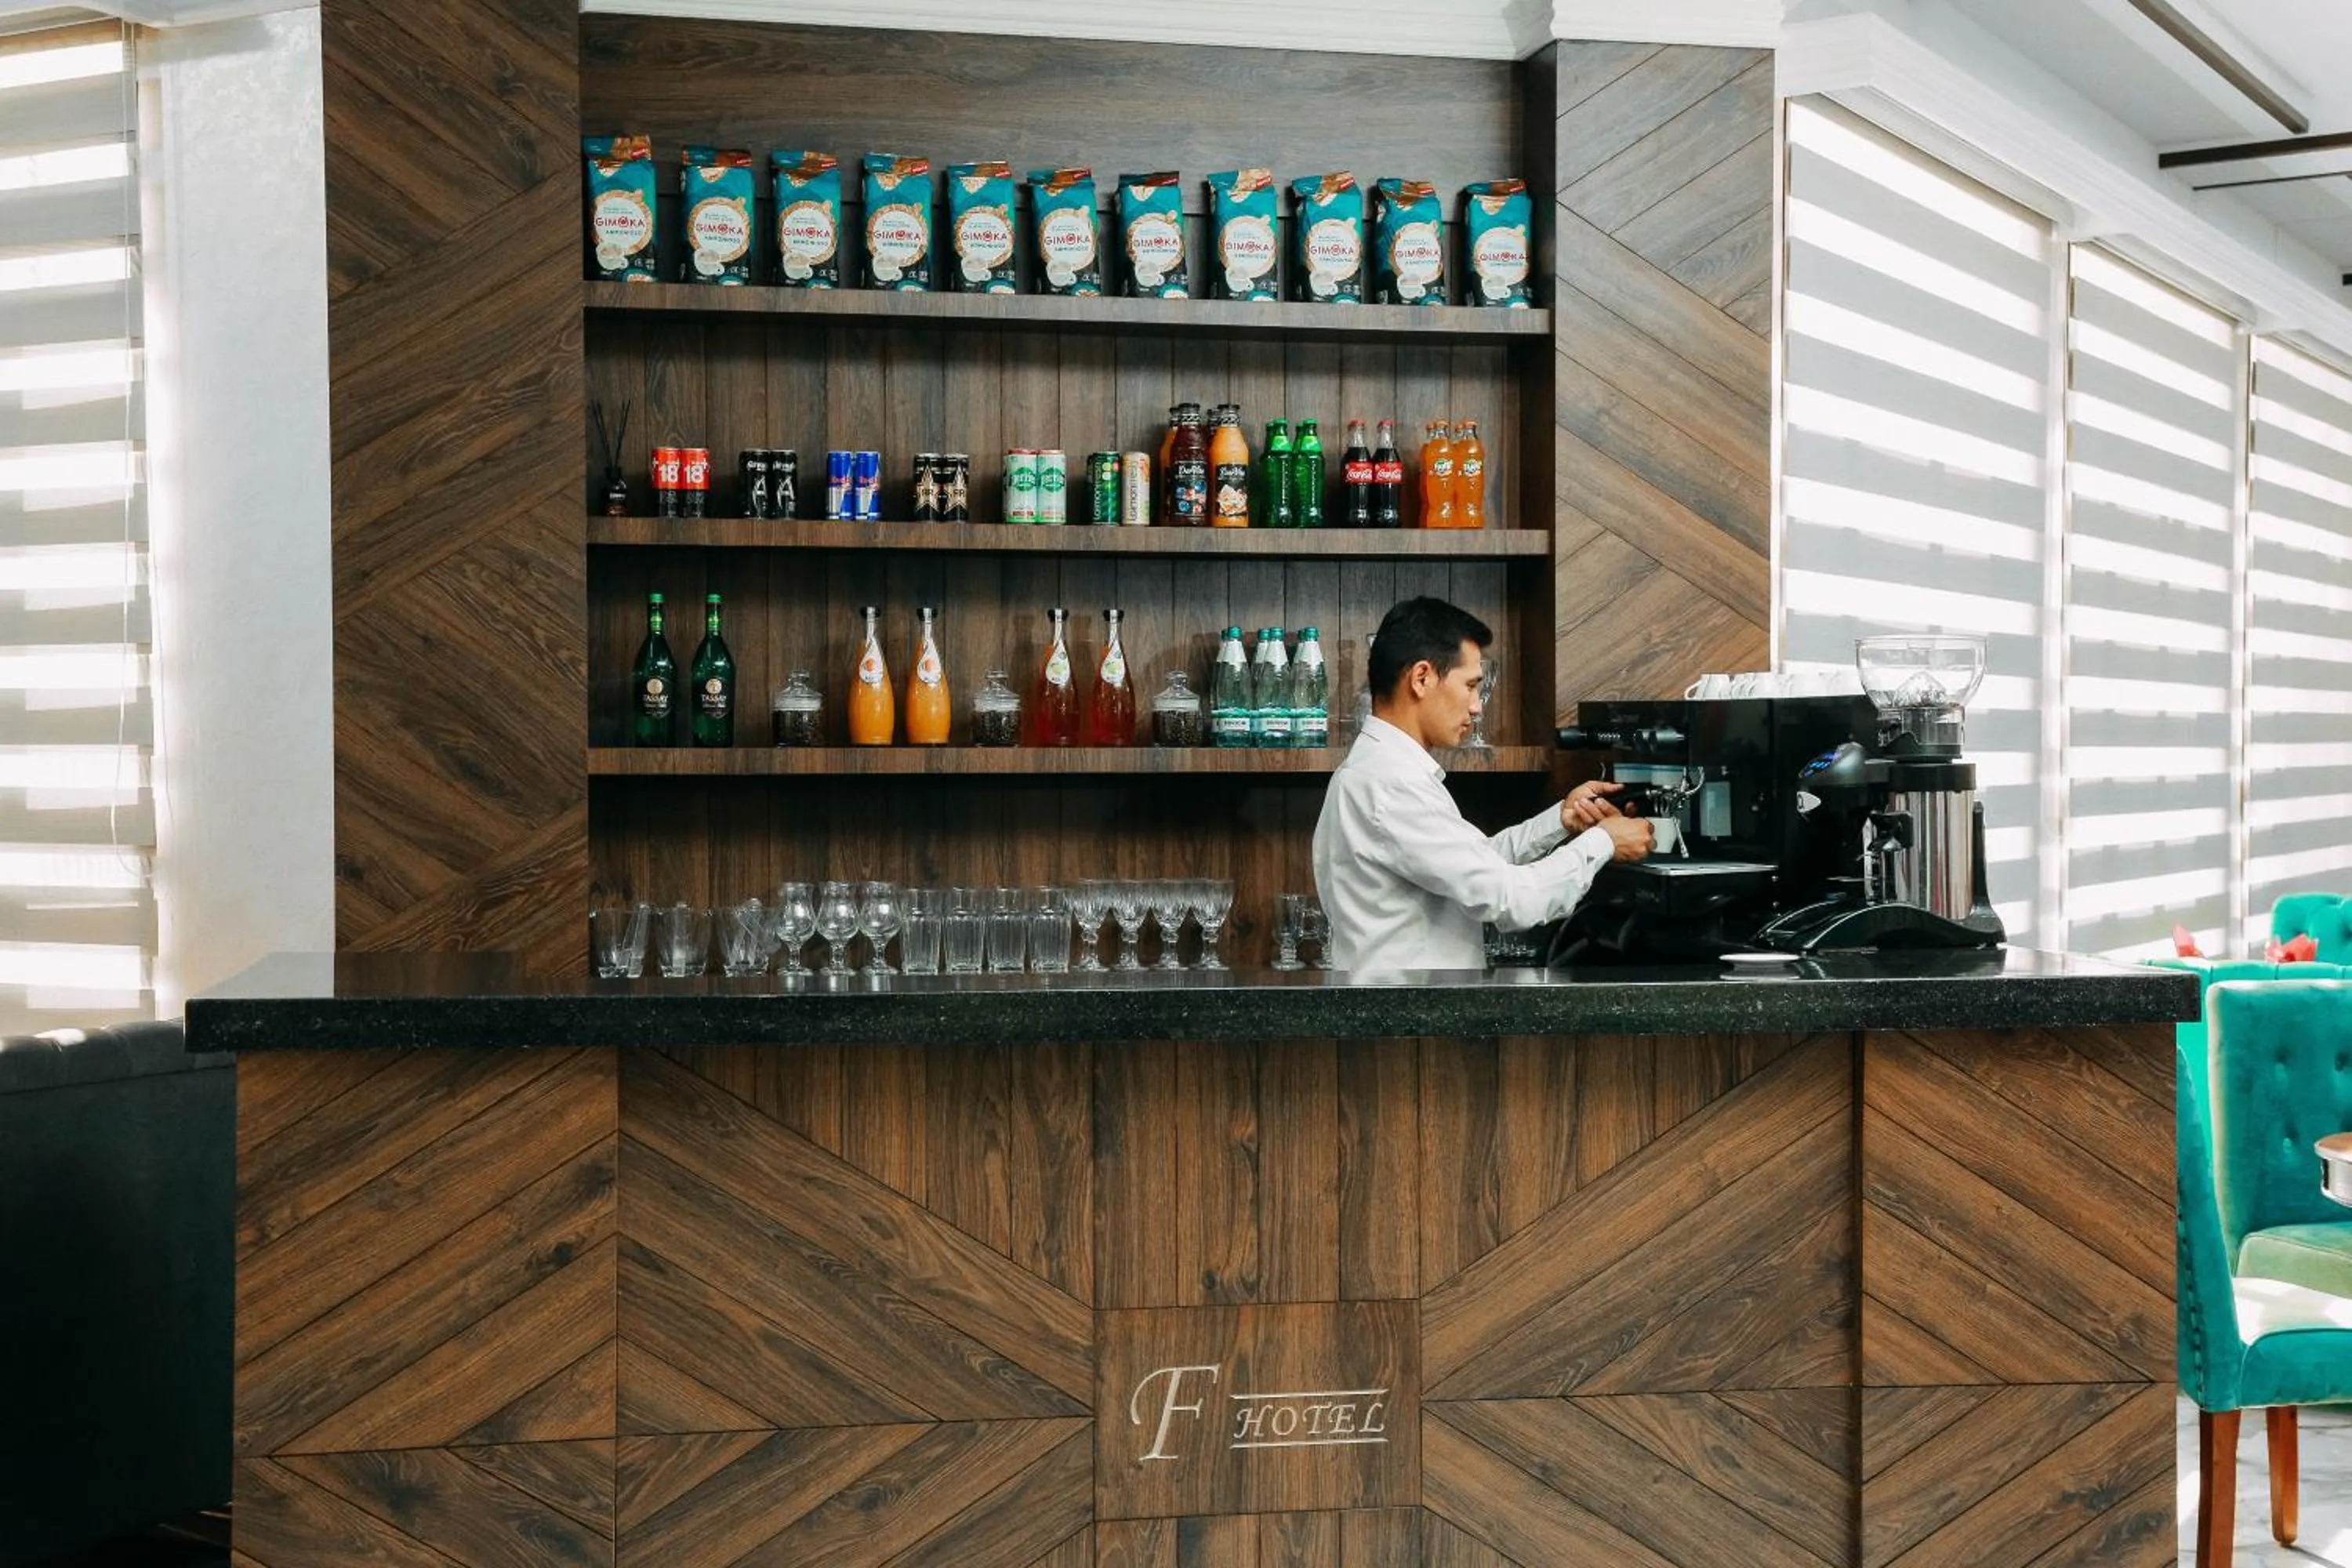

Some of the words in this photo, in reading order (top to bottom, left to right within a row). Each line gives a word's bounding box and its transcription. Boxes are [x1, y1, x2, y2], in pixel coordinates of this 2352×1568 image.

[595, 216, 645, 228] GIMOKA
[696, 223, 743, 236] GIMOKA
[783, 227, 830, 238] GIMOKA
[874, 230, 921, 241] GIMOKA
[961, 230, 1007, 241] GIMOKA
[1044, 233, 1091, 245] GIMOKA
[1134, 237, 1178, 248] GIMOKA
[1310, 245, 1354, 256] GIMOKA
[1131, 1363, 1221, 1461] F
[1233, 1402, 1385, 1439] HOTEL
